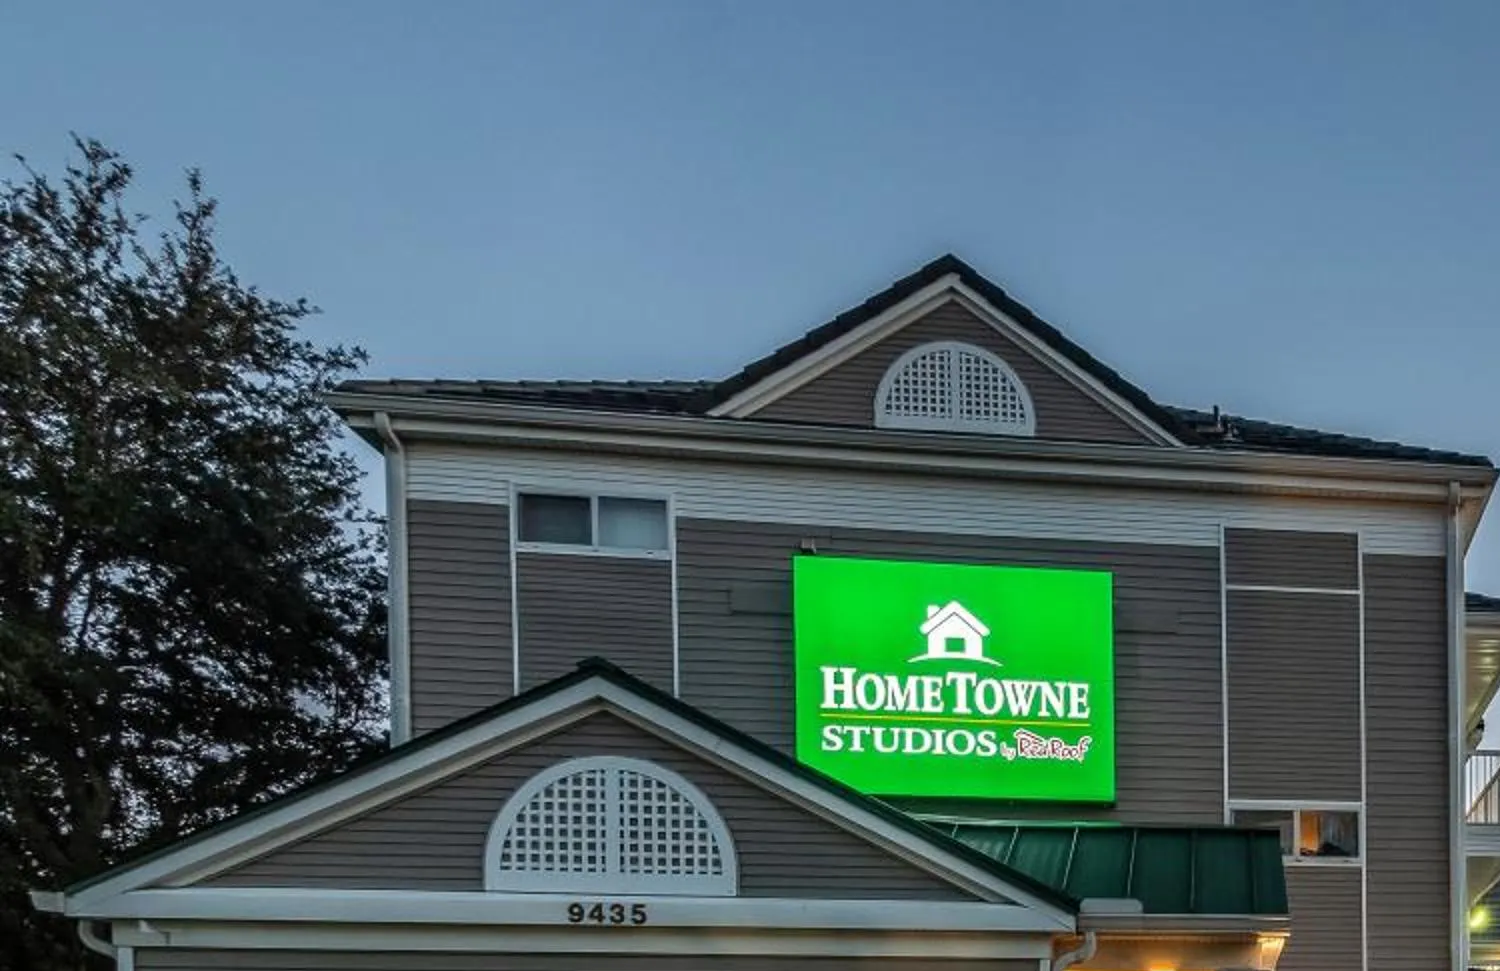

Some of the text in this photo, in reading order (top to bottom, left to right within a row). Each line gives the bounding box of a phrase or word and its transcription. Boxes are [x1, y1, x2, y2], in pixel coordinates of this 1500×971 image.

[821, 725, 997, 756] STUDIOS
[1000, 741, 1017, 761] by
[567, 902, 648, 925] 9435
